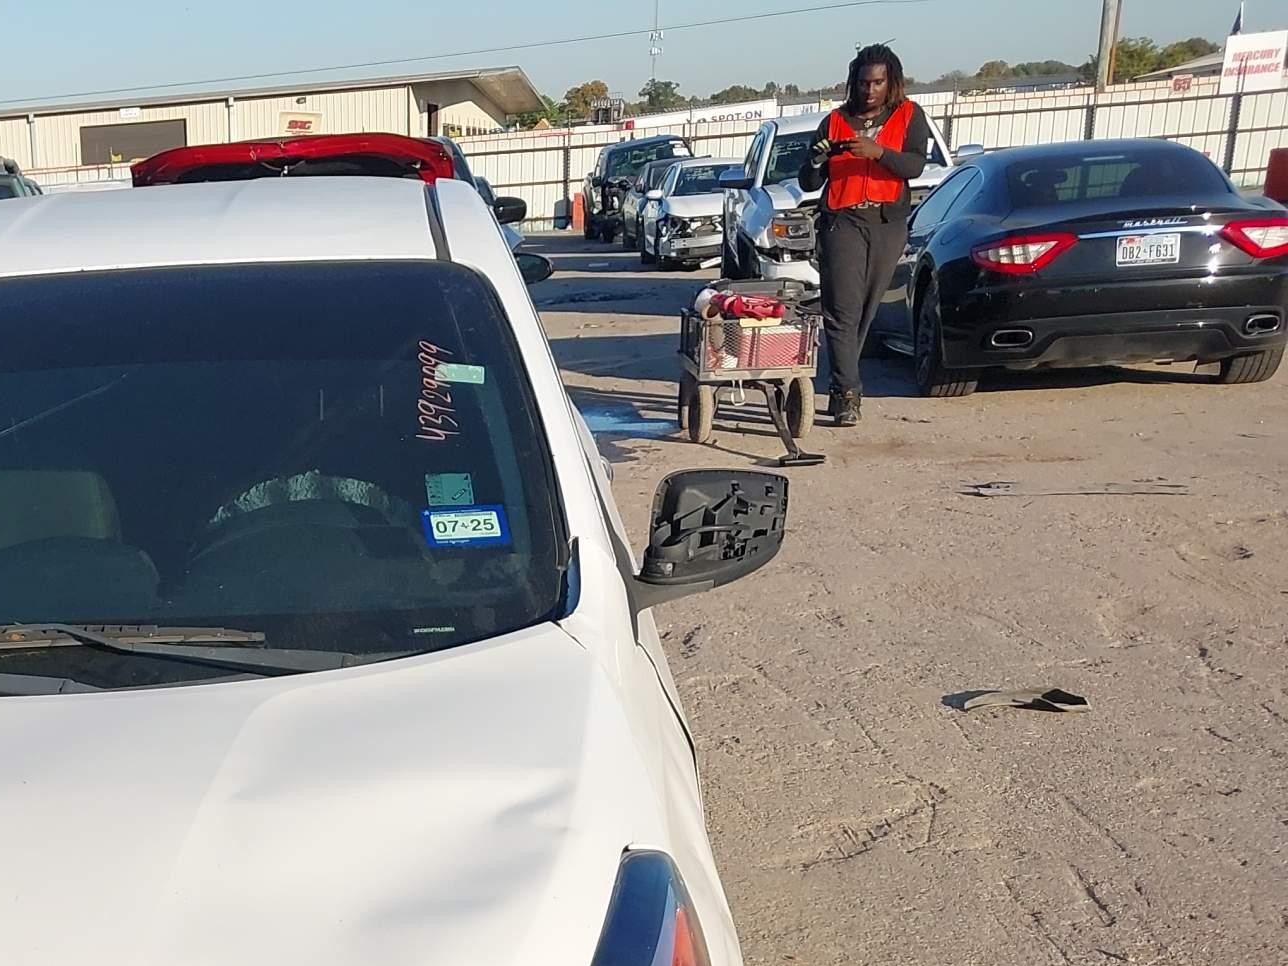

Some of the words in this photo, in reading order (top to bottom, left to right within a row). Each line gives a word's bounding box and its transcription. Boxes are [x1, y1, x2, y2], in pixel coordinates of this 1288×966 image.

[1232, 48, 1281, 61] MERCURY
[1223, 62, 1281, 77] INSURANCE
[711, 109, 763, 122] SPOT-ON
[435, 520, 459, 534] 07
[469, 517, 495, 532] 25
